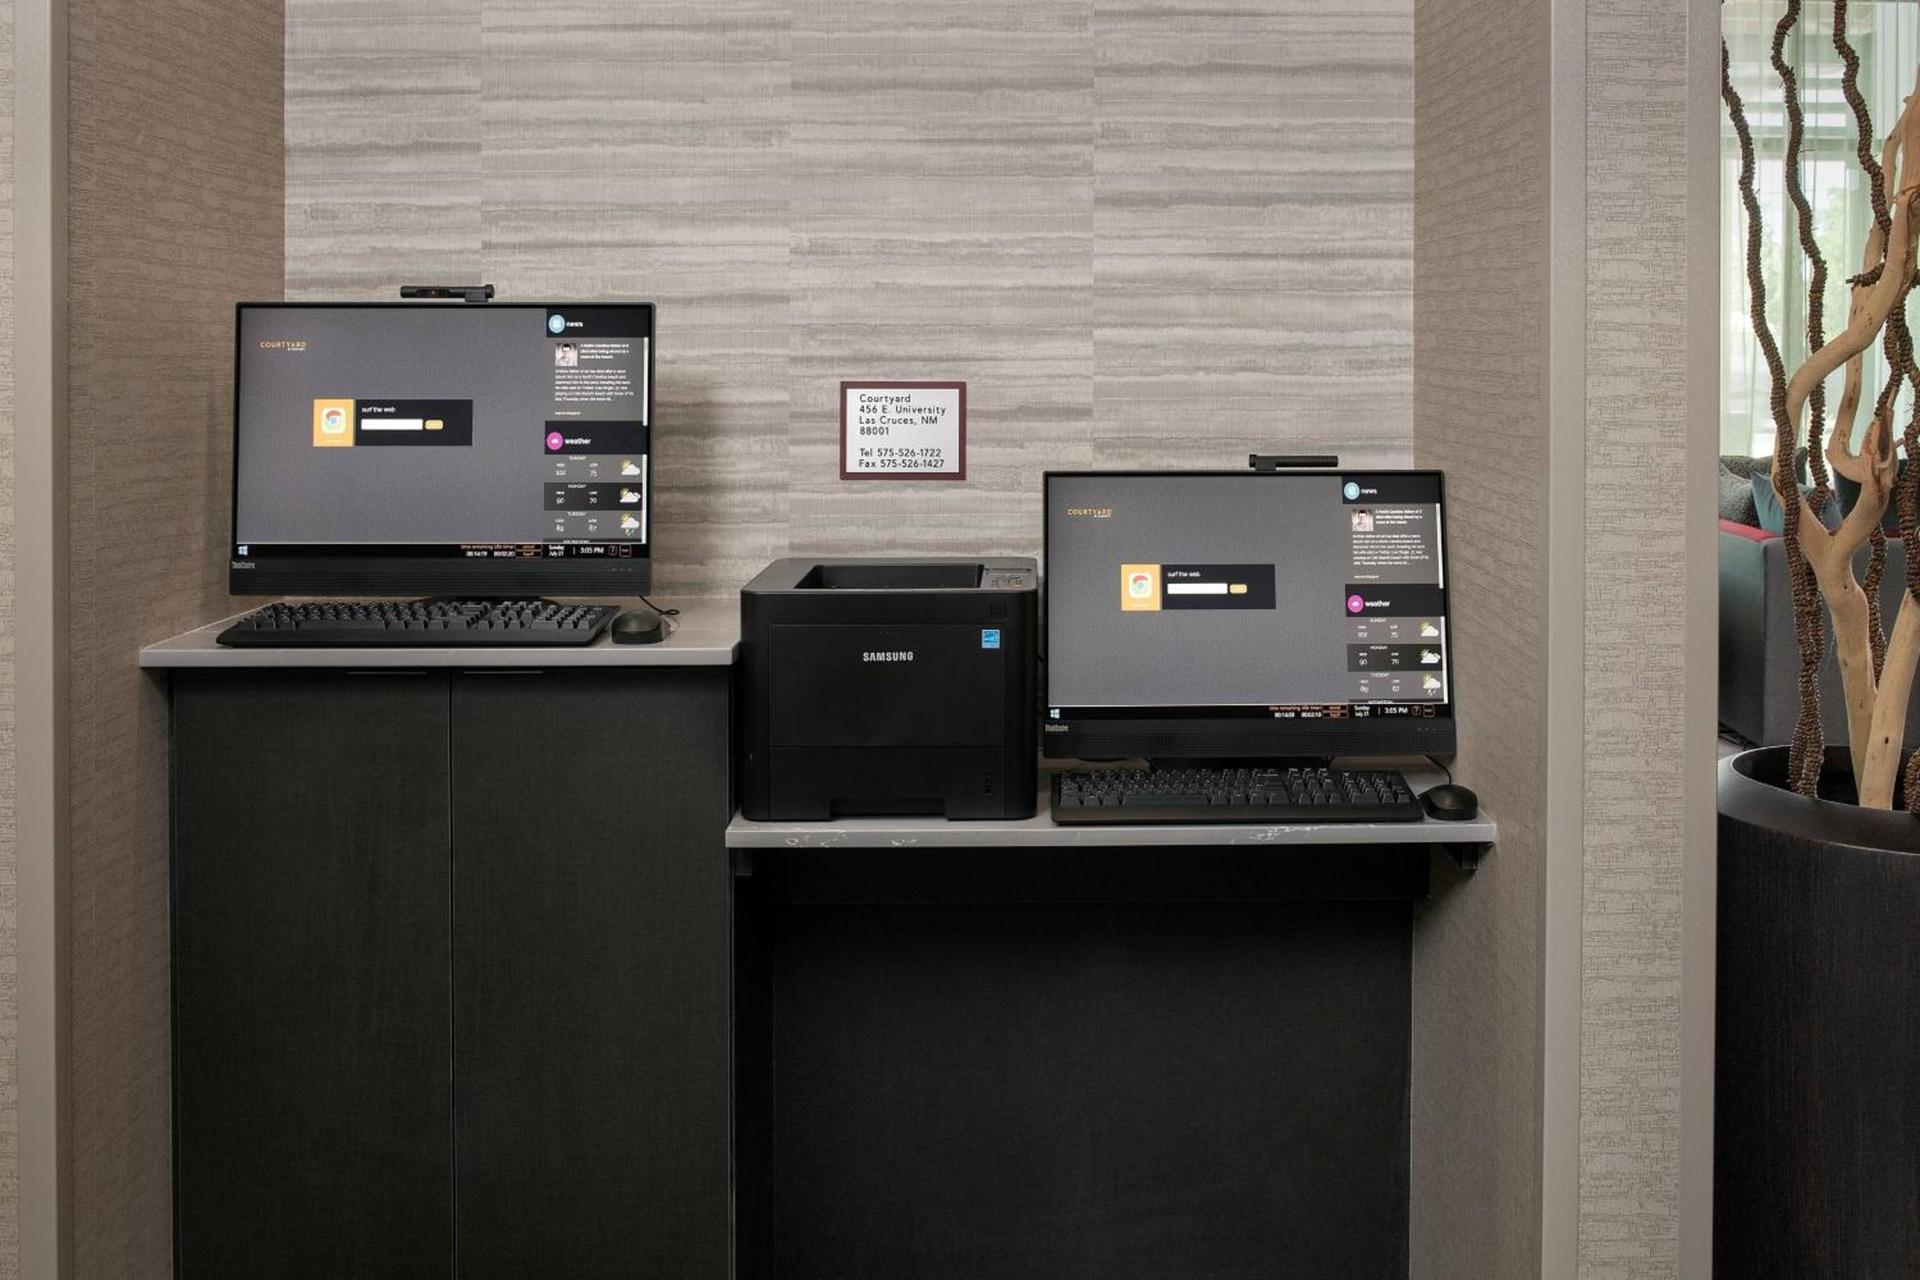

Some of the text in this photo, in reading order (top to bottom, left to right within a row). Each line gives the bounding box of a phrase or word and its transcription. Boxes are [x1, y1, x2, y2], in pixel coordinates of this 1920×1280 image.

[859, 394, 911, 405] Courtyard
[859, 405, 946, 416] 456 E. University
[859, 416, 938, 426] Las Cruces, NM
[859, 427, 890, 436] 88001
[860, 448, 942, 457] Tel 575-526-1722
[859, 459, 945, 468] Fax 575-526-1427
[1066, 508, 1112, 516] COURTYARD
[863, 651, 914, 661] SAMSUNG
